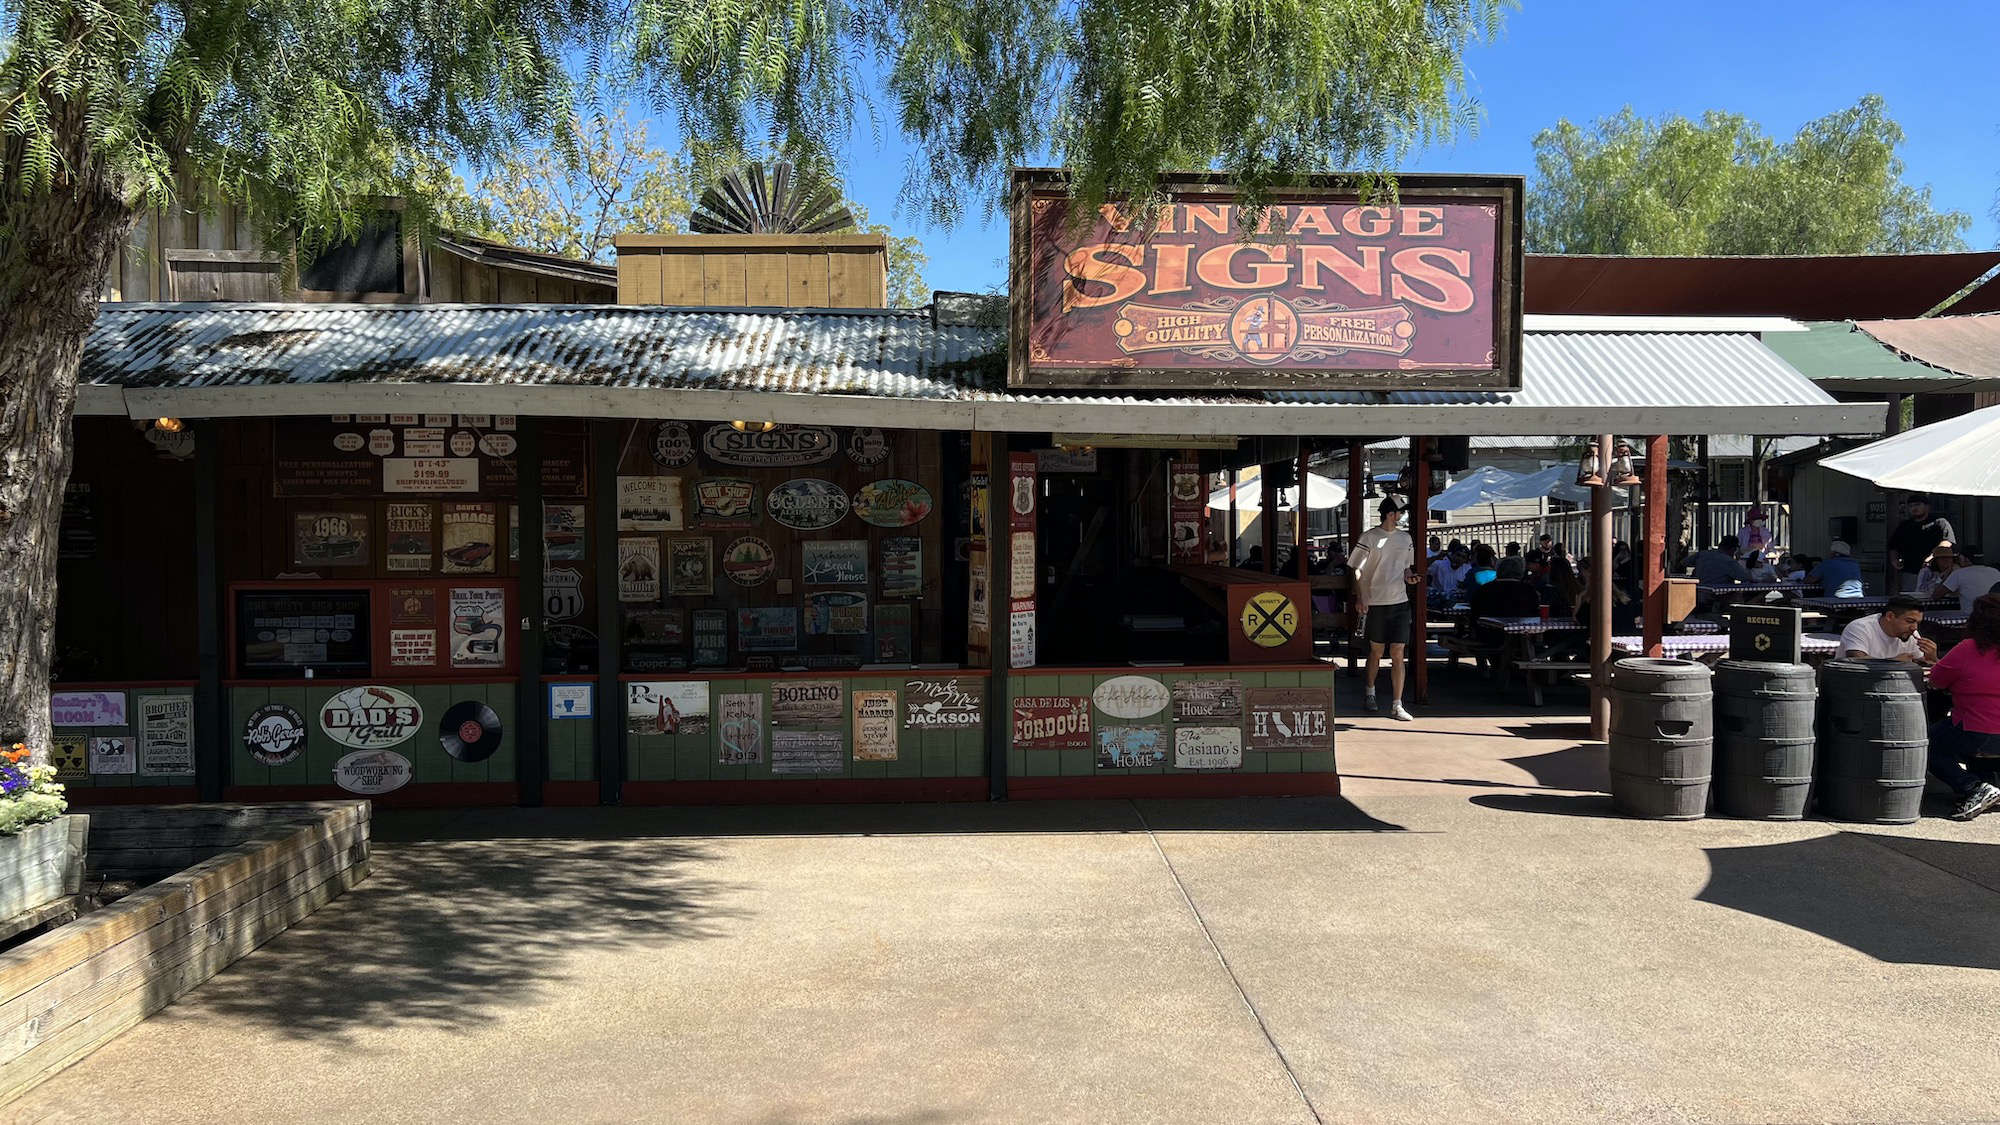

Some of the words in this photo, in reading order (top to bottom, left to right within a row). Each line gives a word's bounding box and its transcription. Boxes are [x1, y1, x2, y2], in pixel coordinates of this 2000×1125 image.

[1100, 204, 1443, 236] VINTAGE
[1063, 241, 1475, 315] SIGNS
[1157, 315, 1201, 330] HIGH
[1330, 316, 1376, 331] FREE
[1145, 323, 1226, 343] QUALITY
[1303, 324, 1393, 347] PERSONALIZATION
[727, 432, 816, 450] SIGNS
[624, 481, 657, 493] WELCOME
[836, 571, 865, 582] House
[547, 597, 575, 616] 01
[1248, 614, 1258, 626] R
[1282, 613, 1293, 625] R
[1746, 616, 1781, 625] RECYCLE
[695, 634, 725, 649] PARK
[631, 685, 657, 704] R
[778, 686, 839, 702] BORINO
[145, 702, 188, 714] BROTHER
[863, 699, 889, 708] JUST
[1014, 698, 1037, 708] CASA
[1039, 698, 1053, 708] DE
[1053, 698, 1070, 708] LOS
[1181, 701, 1213, 717] House
[53, 710, 95, 723] ROOM
[331, 708, 413, 727] DAD'S
[906, 713, 981, 724] JACKSON
[1014, 712, 1090, 742] CORDOVA
[351, 725, 404, 745] Grill
[1178, 730, 1200, 742] The
[1178, 741, 1239, 756] Casiano's
[1116, 754, 1153, 768] HOME
[361, 775, 384, 787] SHOP
